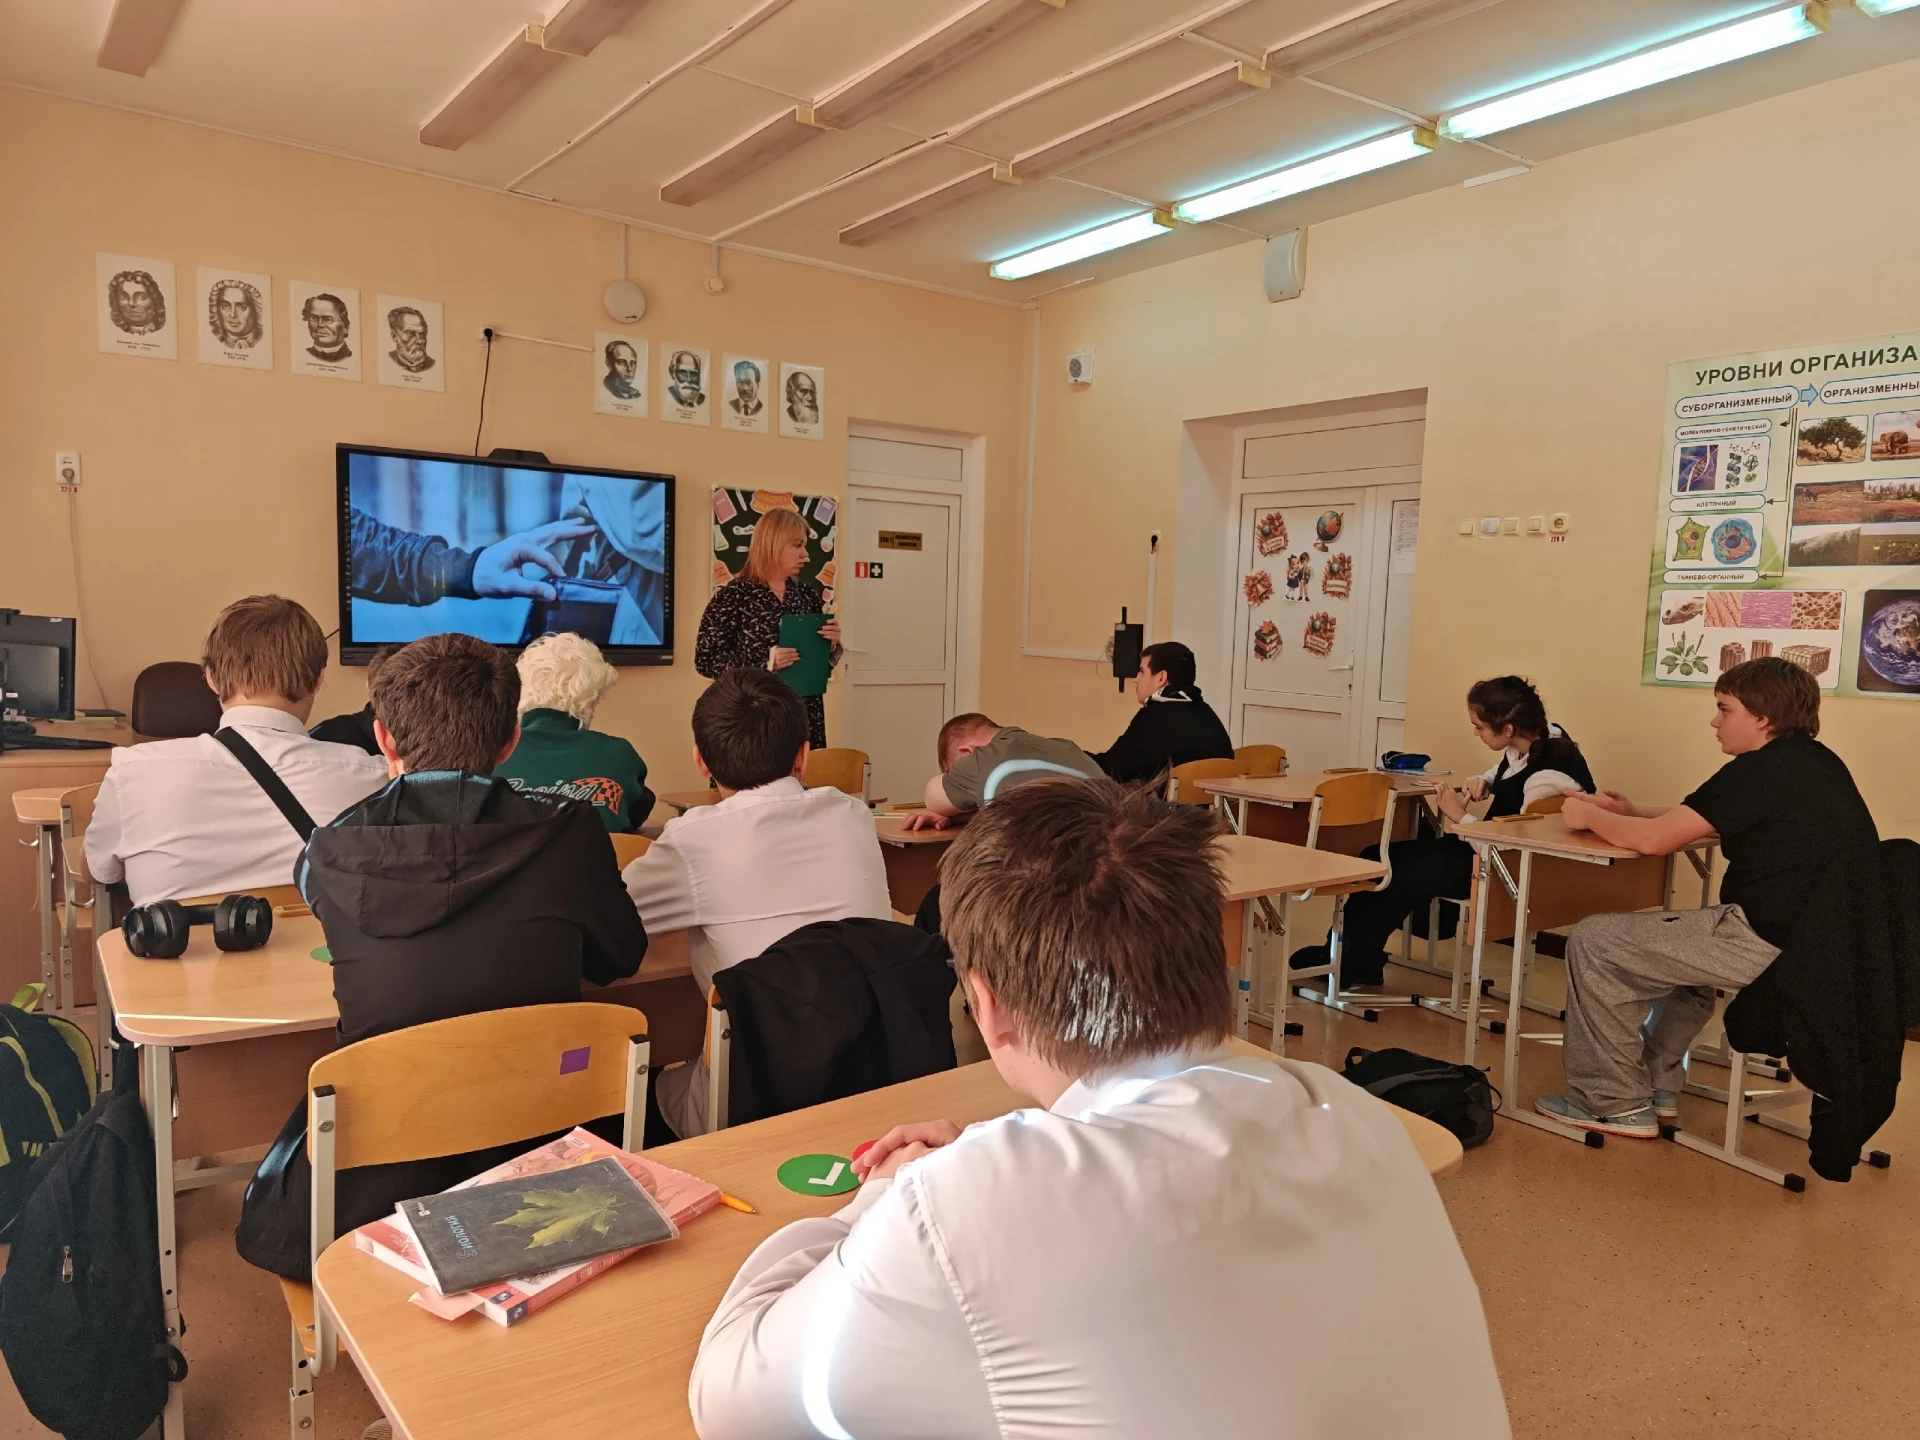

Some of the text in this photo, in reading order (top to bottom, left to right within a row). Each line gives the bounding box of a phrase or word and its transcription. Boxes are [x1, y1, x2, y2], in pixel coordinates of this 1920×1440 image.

[1695, 345, 1918, 386] УРОВНИ ОРГАНИЗА
[1823, 381, 1919, 399] ОРГАНИЗМЕННЫ
[1681, 393, 1793, 413] СУБОРГАНИЗМЕННЫЙ
[1696, 500, 1737, 508] КЛЕТОЧНЫЙ
